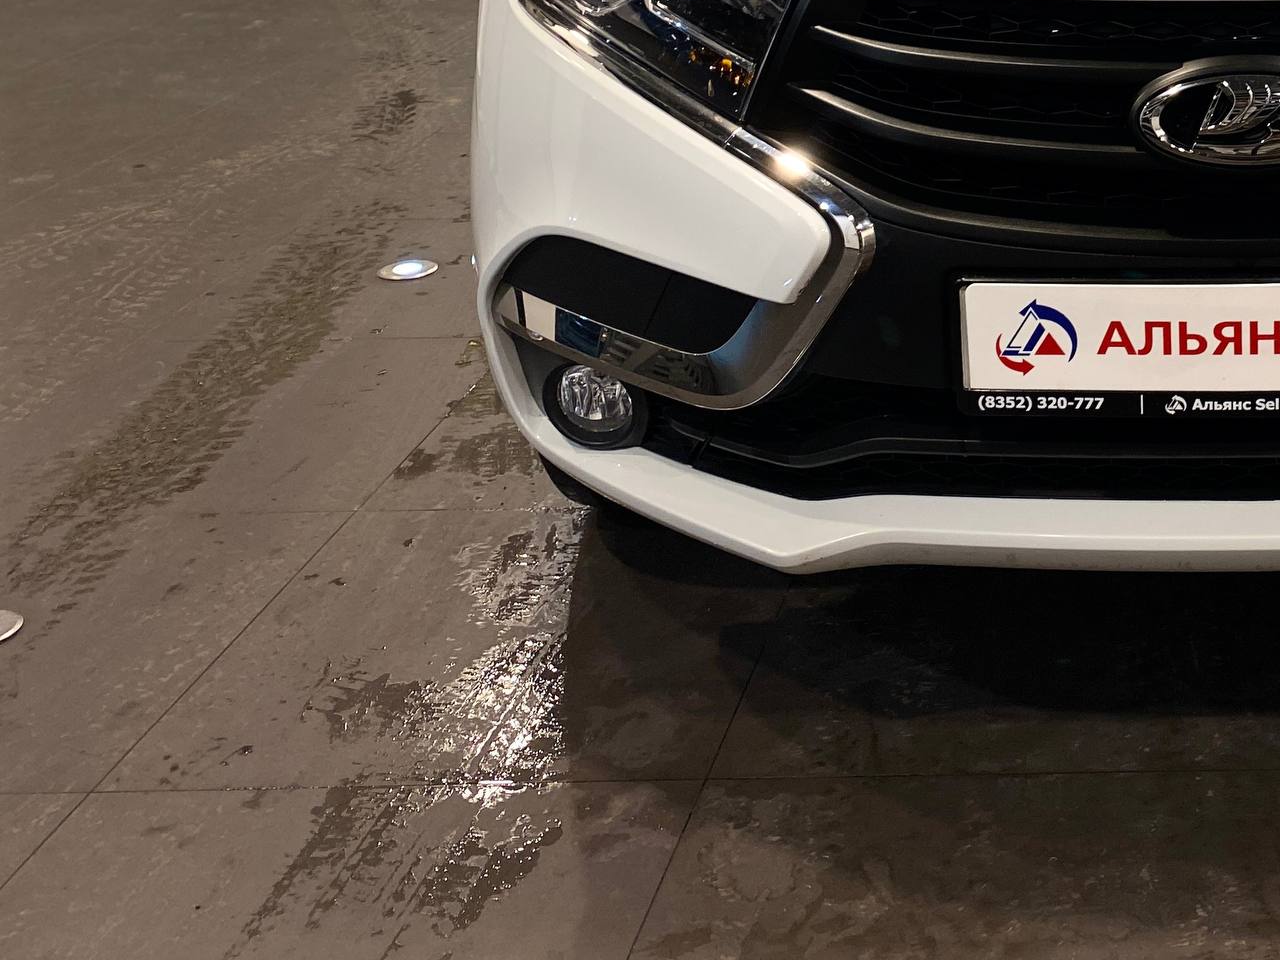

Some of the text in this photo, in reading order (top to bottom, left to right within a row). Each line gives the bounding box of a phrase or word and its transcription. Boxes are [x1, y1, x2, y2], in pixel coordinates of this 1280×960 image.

[977, 395, 1104, 411] (8352) 320-777
[1191, 397, 1251, 411] Альянс
